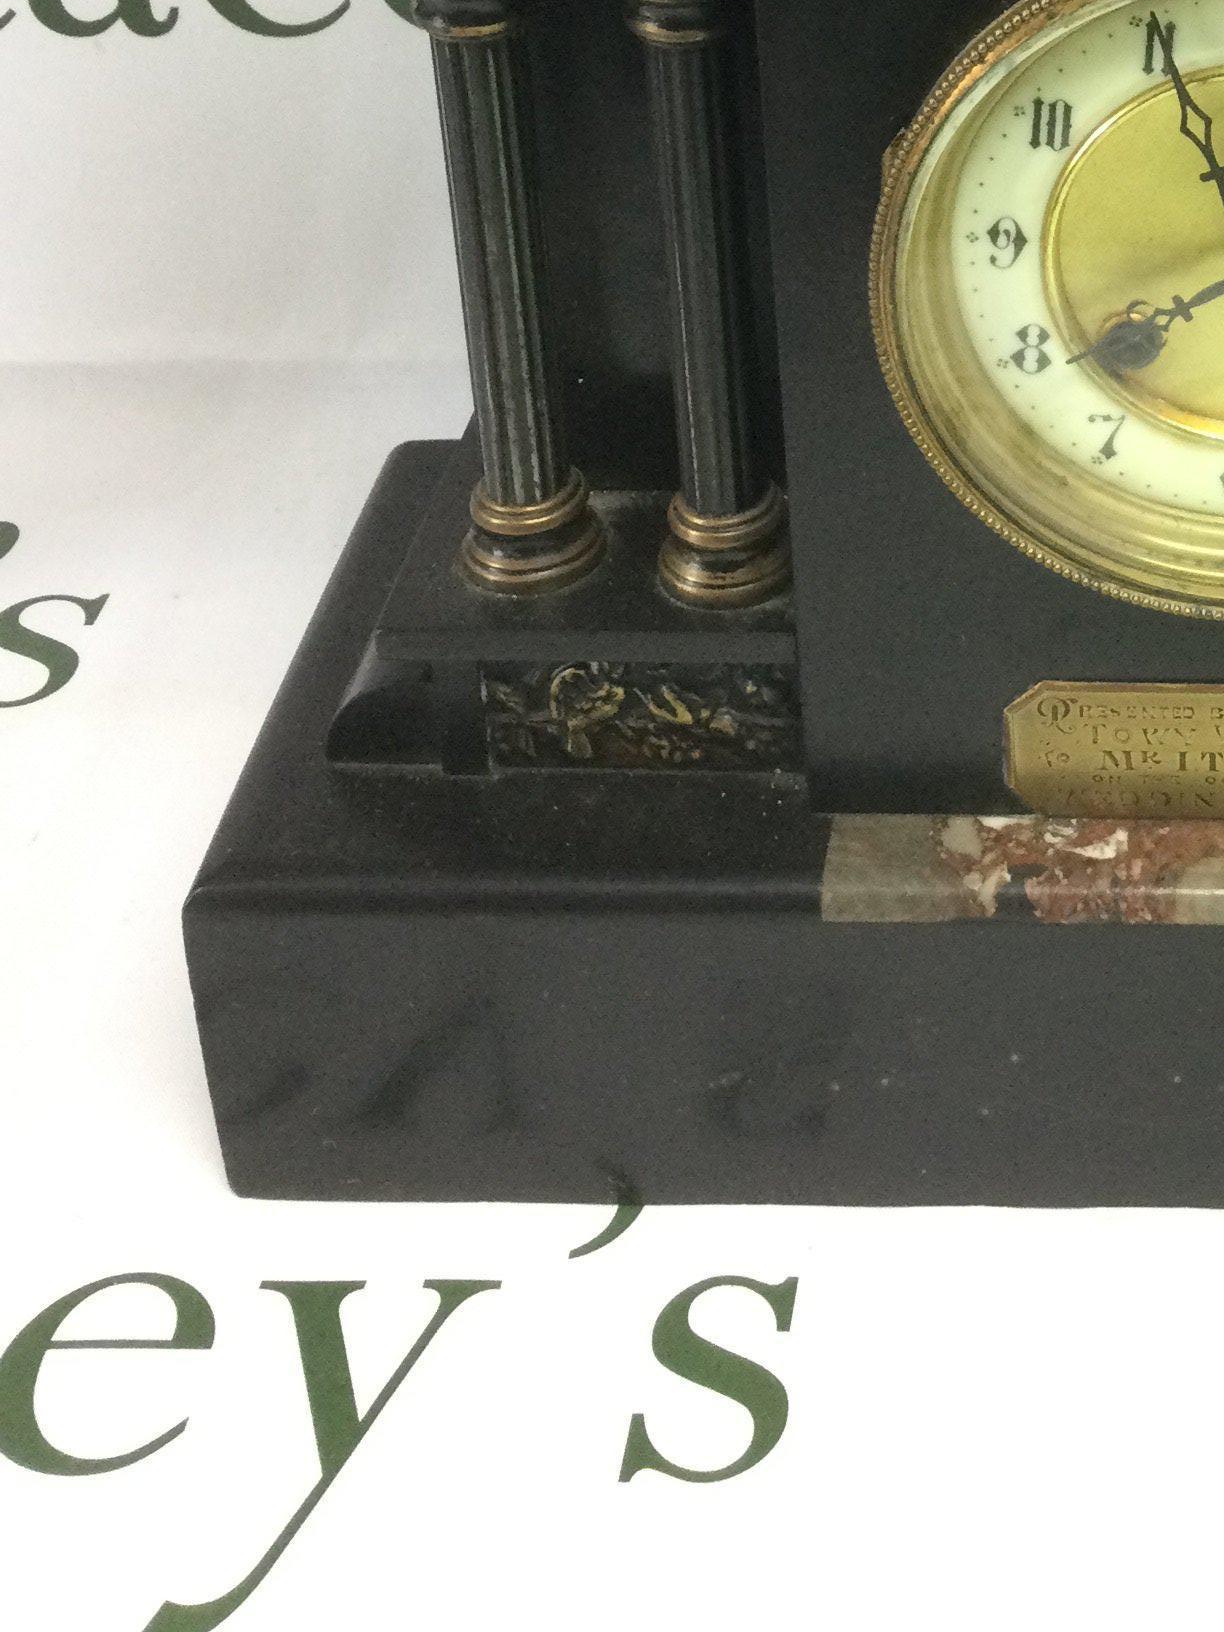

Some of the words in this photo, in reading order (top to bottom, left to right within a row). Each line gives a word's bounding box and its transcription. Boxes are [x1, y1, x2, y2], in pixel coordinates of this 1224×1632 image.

[1027, 97, 1073, 152] 10
[986, 216, 1028, 269] 9
[1009, 323, 1053, 375] 8
[1087, 412, 1126, 461] 7
